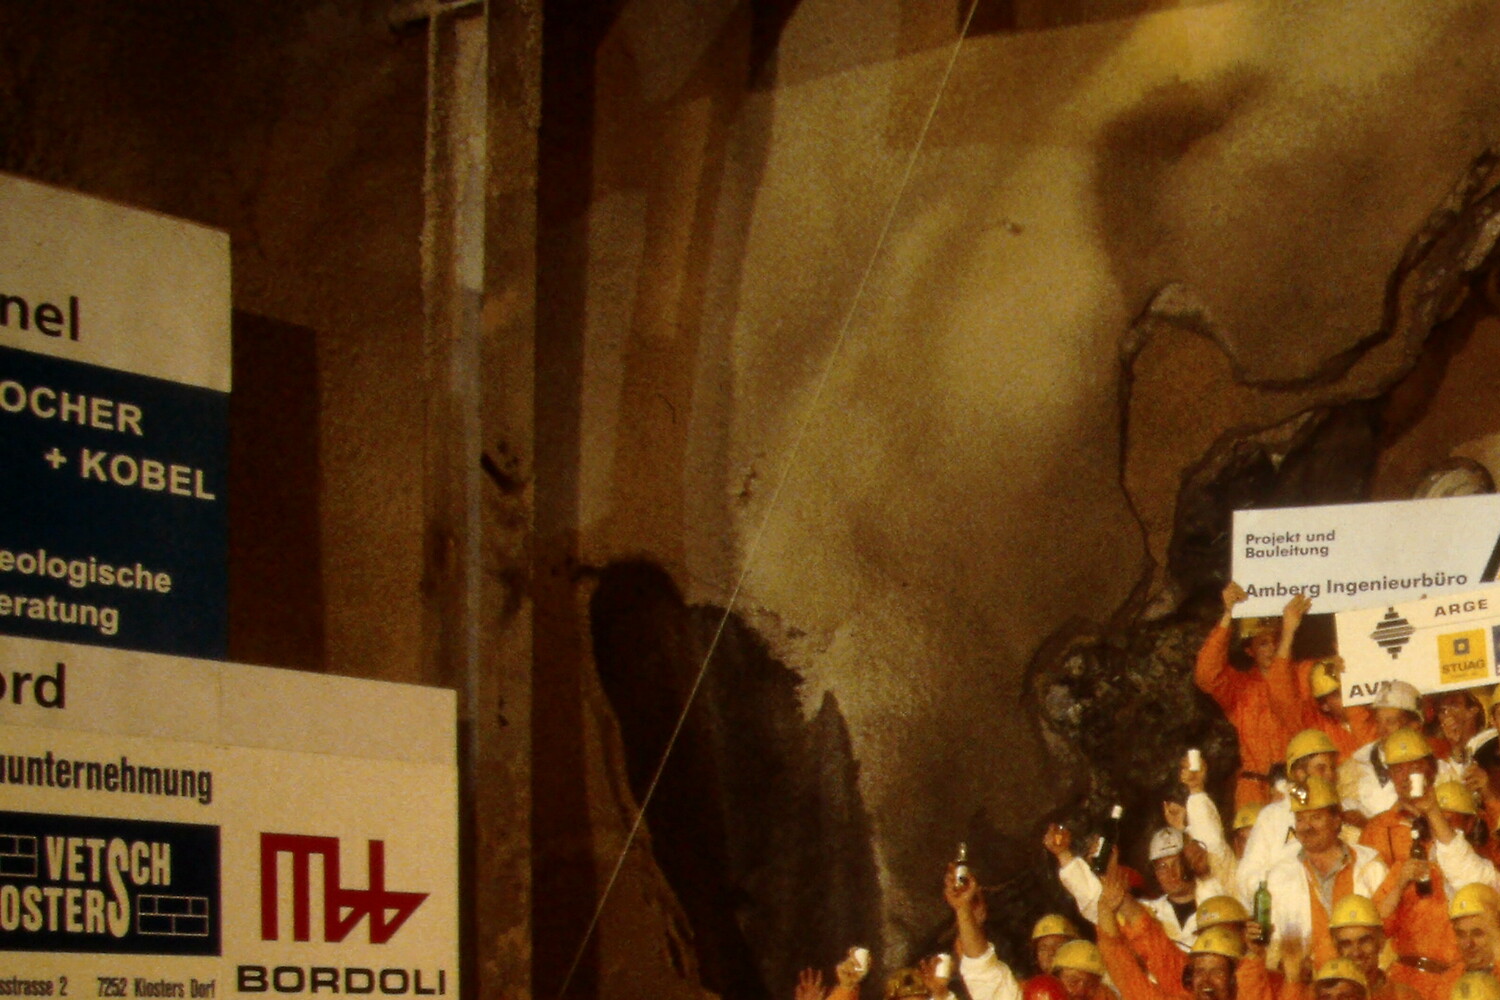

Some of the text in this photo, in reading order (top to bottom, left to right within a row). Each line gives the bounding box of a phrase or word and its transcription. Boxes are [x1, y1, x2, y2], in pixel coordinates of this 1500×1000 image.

[44, 447, 216, 500] + KOBEL
[1245, 530, 1335, 546] Projekt und
[1245, 545, 1329, 558] Bauleitung
[1246, 572, 1468, 598] Amberg Ingenieurbüro
[1434, 598, 1488, 618] ARGE
[1442, 659, 1486, 675] STUAG
[0, 662, 66, 709] rd
[45, 836, 171, 902] VETSCH
[60, 975, 68, 996] 2
[135, 977, 185, 998] Klosters
[190, 978, 216, 998] Dorf
[237, 965, 446, 995] BORDOLI
